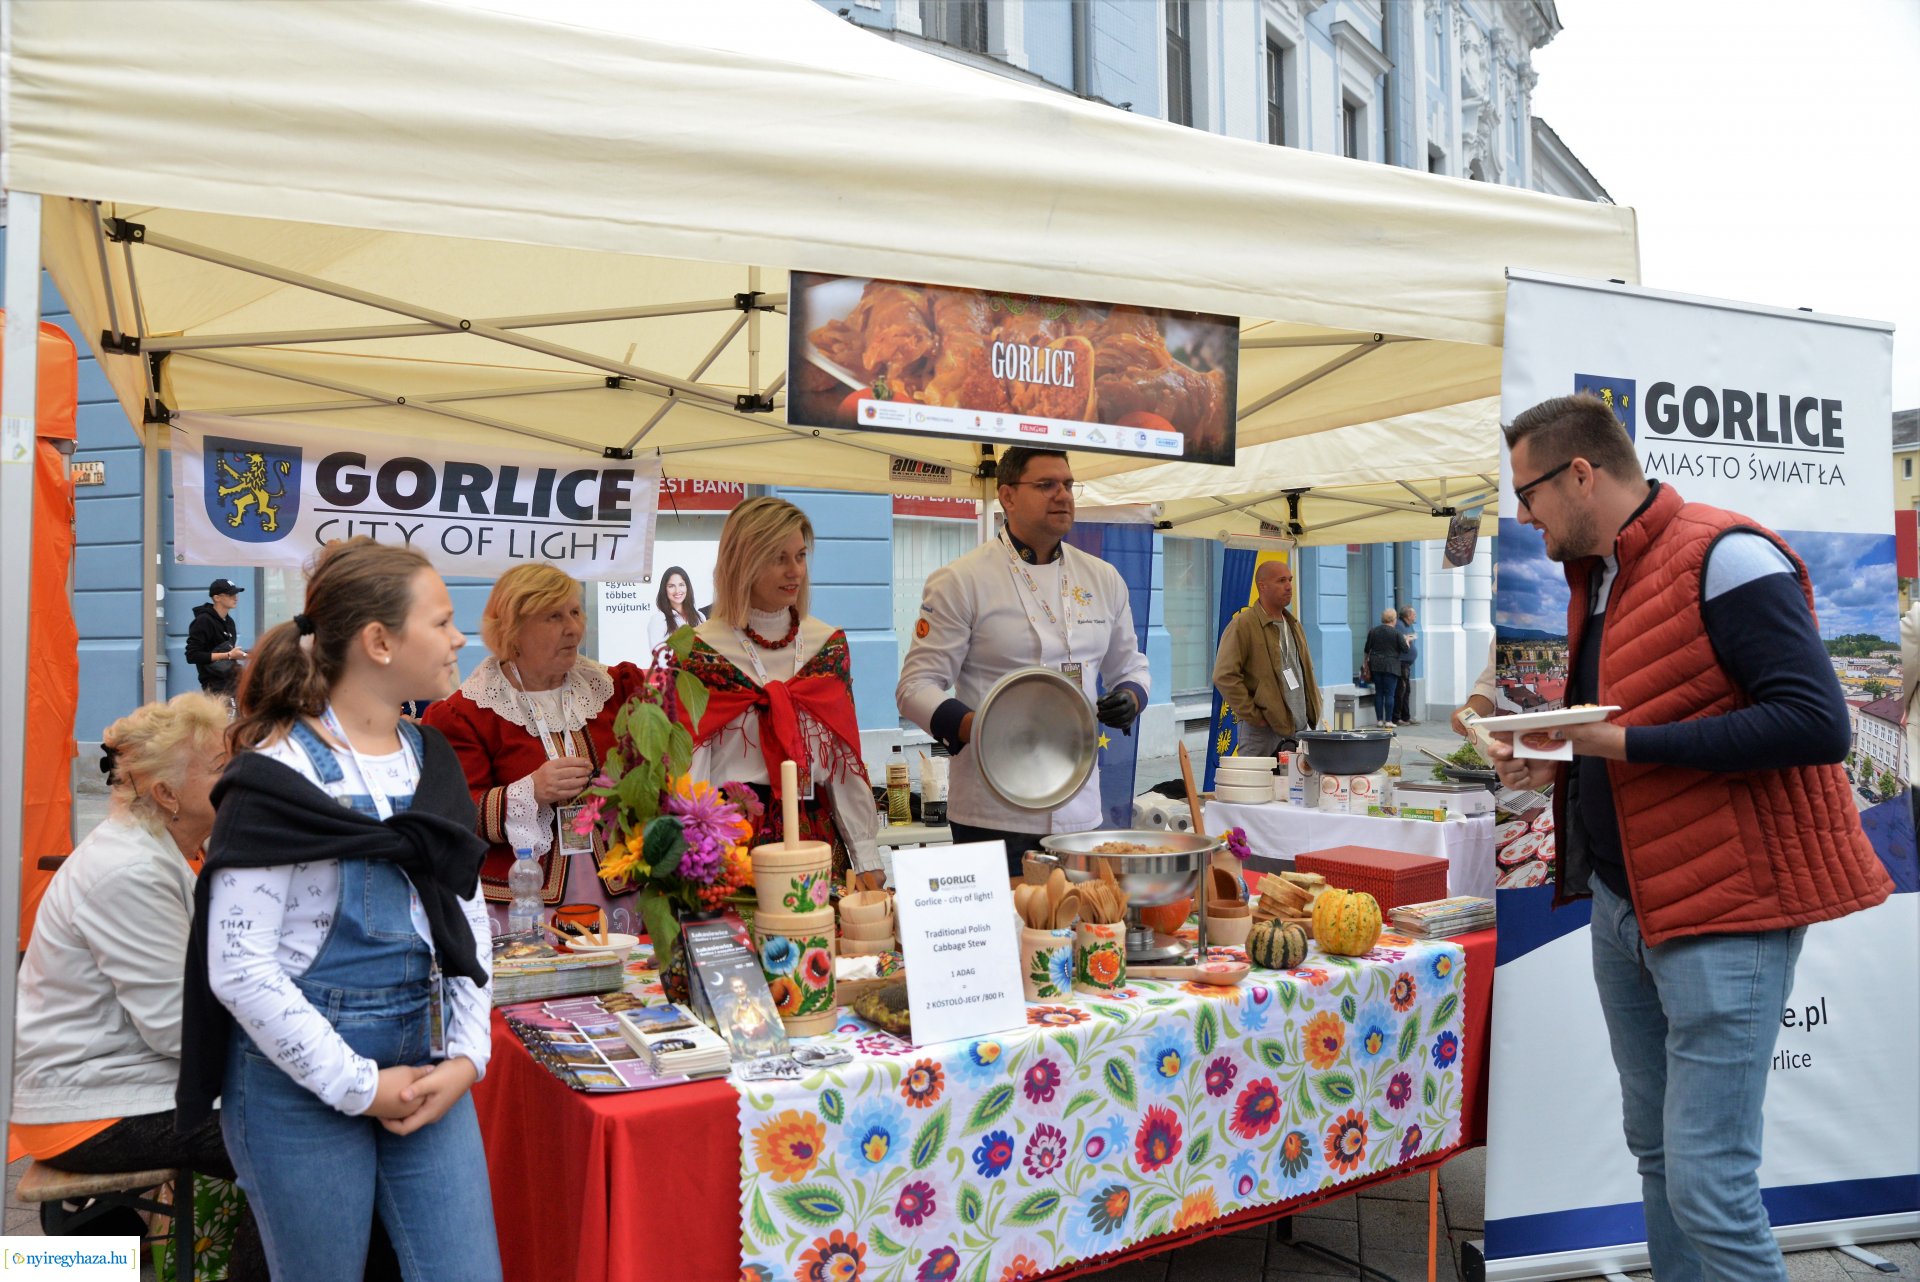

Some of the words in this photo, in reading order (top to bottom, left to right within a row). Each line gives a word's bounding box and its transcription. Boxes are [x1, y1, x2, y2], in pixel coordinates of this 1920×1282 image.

[991, 341, 1075, 388] GORLICE
[1645, 381, 1845, 449] GORLICE
[1645, 450, 1741, 479] MIASTO
[1748, 453, 1846, 486] ŚWIATŁA
[315, 451, 635, 521] GORLICE
[693, 479, 743, 494] BANK
[315, 519, 424, 549] CITY
[440, 525, 493, 556] OF
[510, 529, 629, 560] LIGHT
[605, 590, 637, 599] többet
[605, 602, 651, 614] nyújtunk!
[940, 874, 976, 886] GORLICE
[914, 896, 942, 907] Gorlice
[948, 895, 963, 904] city
[964, 893, 972, 901] of
[973, 891, 993, 902] light!
[219, 919, 254, 930] THAT
[925, 926, 967, 939] Traditional
[968, 924, 991, 933] Polish
[933, 941, 966, 952] Cabbage
[968, 939, 987, 948] Stew
[956, 967, 976, 977] ADAG
[1782, 996, 1828, 1033] e.pl
[1773, 1049, 1812, 1071] rlice
